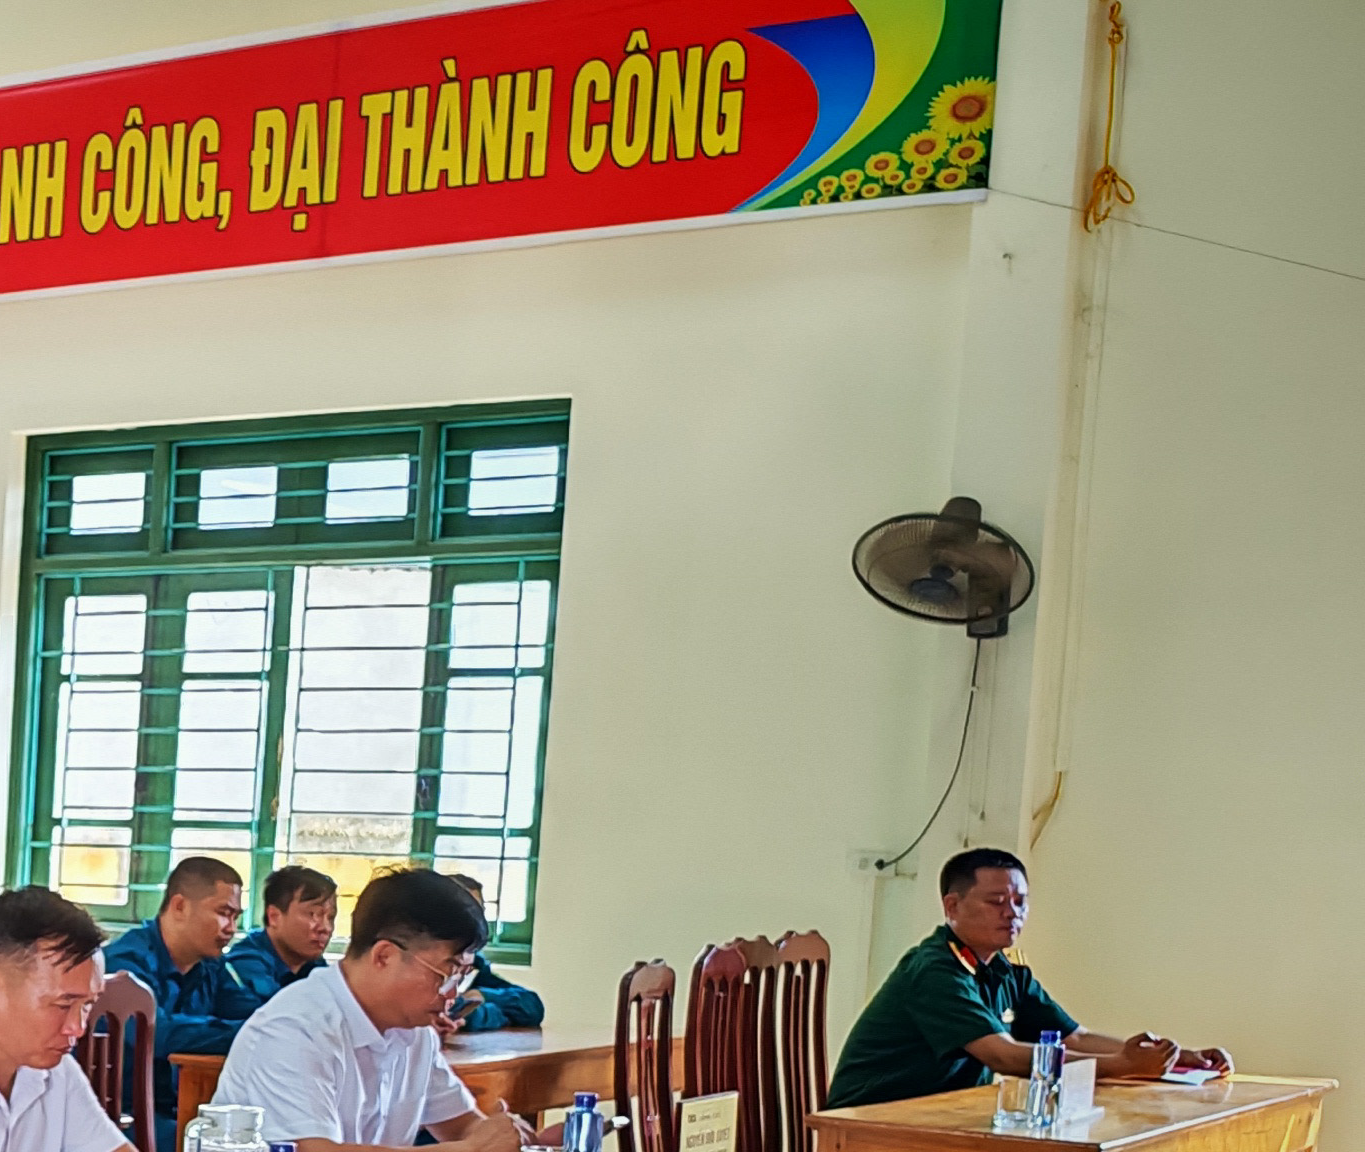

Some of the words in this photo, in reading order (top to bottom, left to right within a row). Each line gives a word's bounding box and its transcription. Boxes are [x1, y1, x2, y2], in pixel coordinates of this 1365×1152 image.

[79, 106, 232, 235] CÔNG,
[249, 98, 346, 232] ĐẠI
[360, 57, 553, 200] THÀNH
[568, 28, 747, 175] CÔNG
